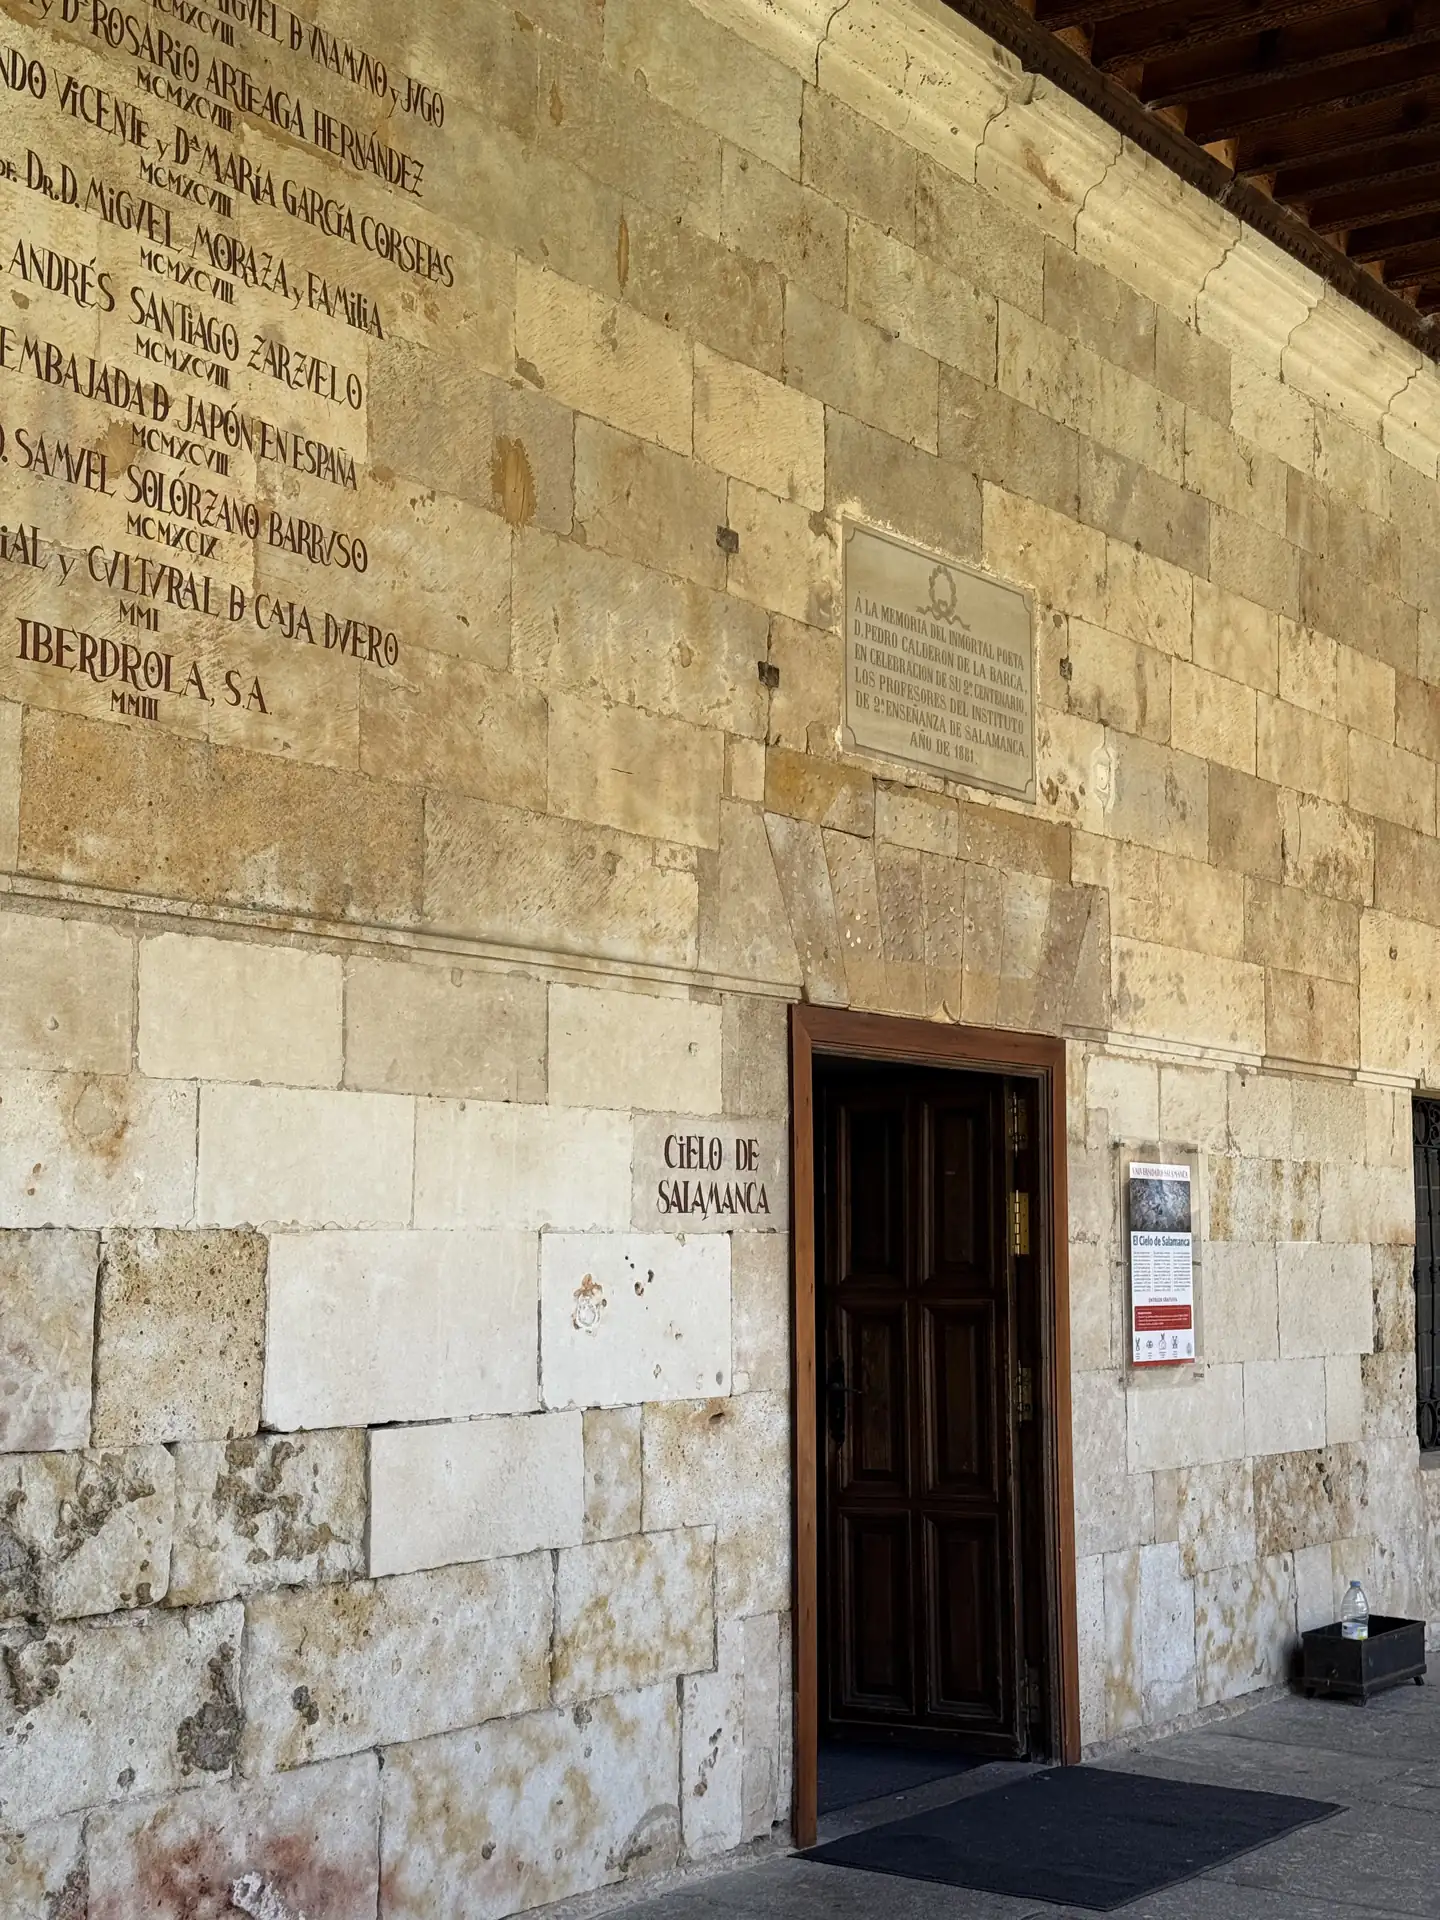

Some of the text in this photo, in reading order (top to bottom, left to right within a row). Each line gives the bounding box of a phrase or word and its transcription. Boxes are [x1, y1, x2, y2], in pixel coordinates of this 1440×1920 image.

[135, 65, 235, 133] MCMXCVIII
[203, 57, 305, 141] ARTEAGA
[313, 107, 424, 198] HERNÁNDEZ
[138, 155, 234, 219] MCMXCVIII
[7, 238, 115, 312] ANDRÉS
[139, 245, 236, 306] MCMXCVIII
[187, 223, 292, 300] MORAZA
[133, 332, 231, 391] MCMXCVIII
[0, 325, 147, 418] EMBAJADA
[174, 393, 254, 457] JAPÓN
[259, 420, 290, 466] EN
[291, 433, 359, 491] ESPAÑA
[129, 422, 231, 477] MCMXCVIII
[124, 466, 260, 540] SOLÓRZANO
[124, 511, 222, 562] MCMXCIX
[119, 598, 161, 632] MMI
[254, 591, 317, 646] CAJA
[864, 597, 880, 620] LA
[880, 603, 928, 637] MEMORIA
[930, 622, 947, 644] DEL
[948, 629, 995, 661] INMORTAL
[996, 645, 1025, 671] POETA
[15, 617, 273, 716] IBERDROLA, S.A.
[854, 642, 868, 663] EN
[869, 647, 934, 685] CELEBRACION
[935, 669, 948, 689] DE
[949, 674, 961, 693] SU
[864, 621, 898, 649] PEDRO
[901, 635, 955, 670] CALDERON
[956, 654, 971, 674] DE
[972, 659, 987, 680] LA
[989, 665, 1028, 697] BARCA,
[109, 689, 161, 723] MMIII
[854, 666, 1025, 736] LOS PROFESORES DEL INSTITUTO
[855, 689, 870, 711] DE
[886, 699, 948, 734] ENSEÑANZA
[949, 719, 962, 739] DE
[963, 723, 1030, 759] SALAMANCA.
[909, 728, 933, 752] AÑO
[936, 738, 951, 757] DE
[735, 1138, 760, 1171] DE
[657, 1179, 771, 1221] SALAMANCA
[1132, 1235, 1190, 1247] El Cielo de Salamanca
